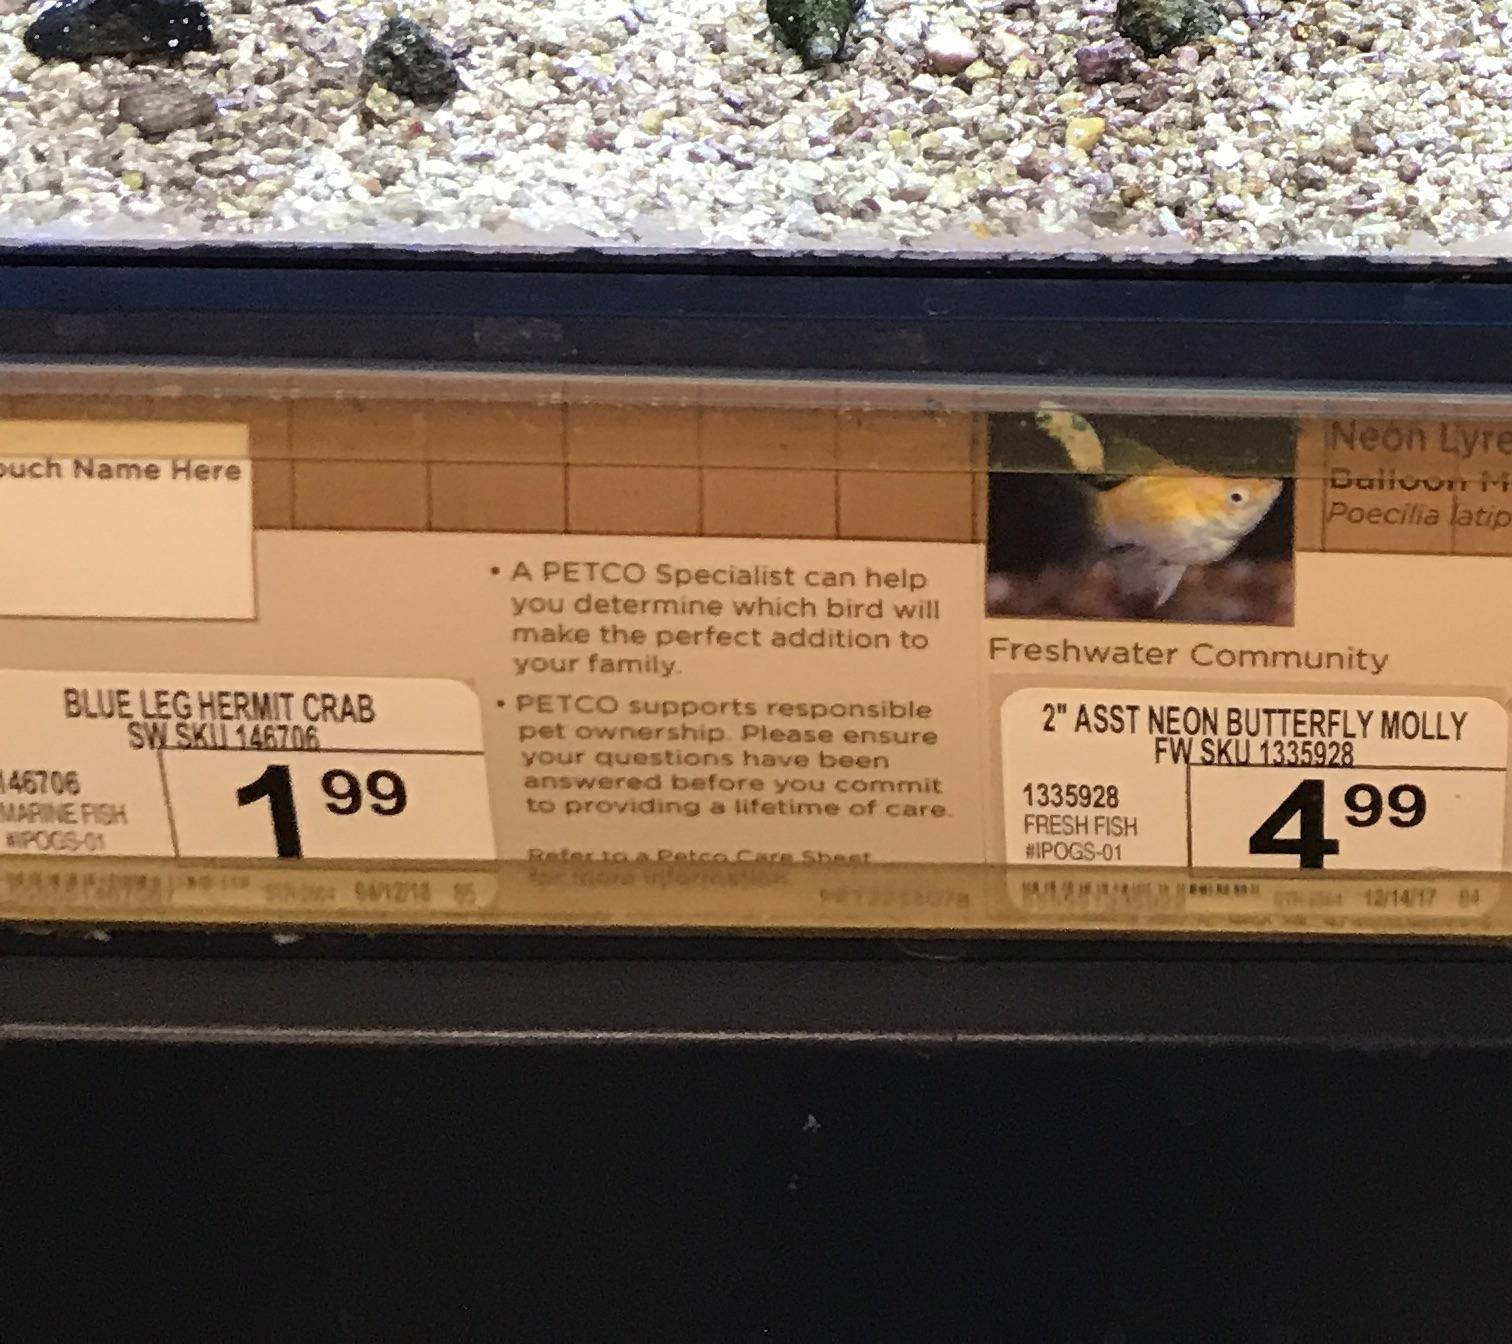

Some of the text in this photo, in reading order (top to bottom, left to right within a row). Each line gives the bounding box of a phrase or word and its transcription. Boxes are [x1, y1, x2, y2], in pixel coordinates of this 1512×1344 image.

[1330, 420, 1426, 453] Neon
[0, 457, 241, 481] uch Name Here
[1329, 503, 1440, 527] Poecilia
[511, 561, 928, 592] A PETCO Specialist can help
[511, 592, 940, 620] you determine which bird will
[512, 624, 928, 651] make the perfect addition to
[513, 653, 682, 677] your family.
[989, 638, 1389, 675] Freshwater Community
[63, 688, 376, 723] BLUE LEG HERMIT CRAB
[516, 695, 932, 722] PETCO supports responsible
[519, 723, 938, 746] pet ownership. Please ensure
[1042, 704, 1467, 741] 2" ASST NEON BUTTERFLY MOLLY
[127, 722, 321, 751] SW SKU 146706
[521, 750, 890, 770] your questions have been
[1154, 738, 1355, 768] FW SKU 1335928
[321, 769, 407, 816] 99
[523, 774, 943, 796] answered before you commit
[1023, 783, 1120, 809] 1335928
[236, 764, 303, 858] 1
[527, 798, 953, 818] to providing a lifetime of care.
[1344, 783, 1427, 828] 99
[1023, 814, 1138, 836] FRESH FISH
[1249, 778, 1340, 869] 4
[1025, 841, 1122, 861] #IPOGS-01
